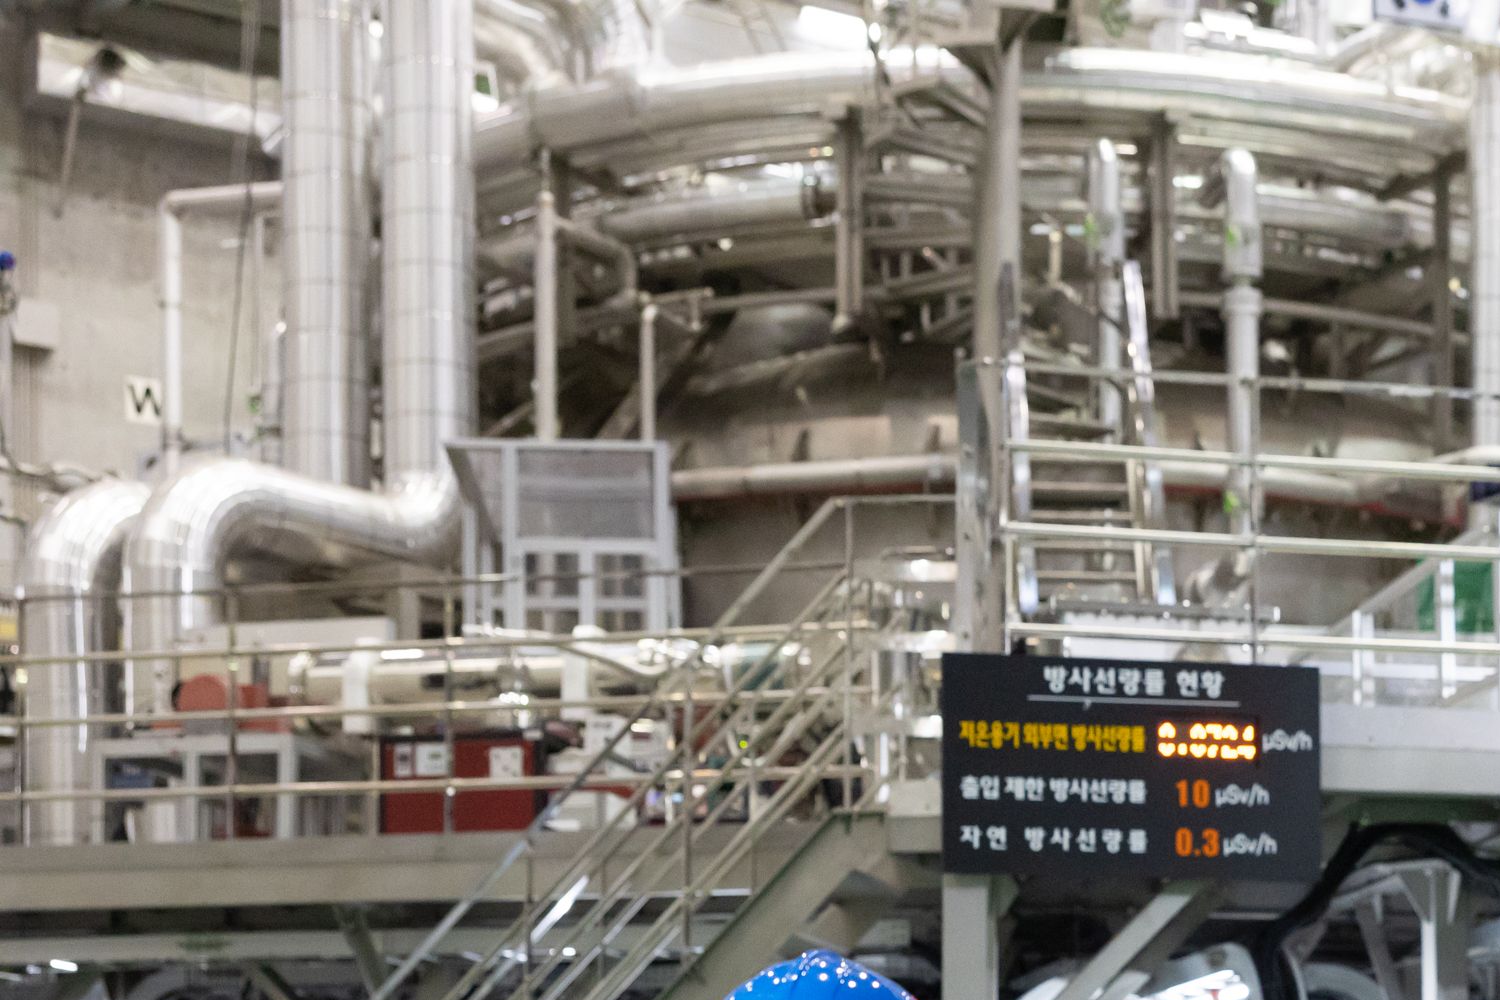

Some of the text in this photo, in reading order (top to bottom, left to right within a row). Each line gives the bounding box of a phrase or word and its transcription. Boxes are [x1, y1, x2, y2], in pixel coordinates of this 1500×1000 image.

[127, 384, 162, 418] W
[1043, 665, 1225, 699] 방사선량률 현황
[1071, 724, 1146, 753] 방사선량률
[960, 775, 1000, 800] 출입
[1004, 776, 1045, 801] 제한
[1050, 778, 1147, 804] 방사선량률
[1176, 779, 1210, 808] 10
[1175, 828, 1220, 857] 0.3
